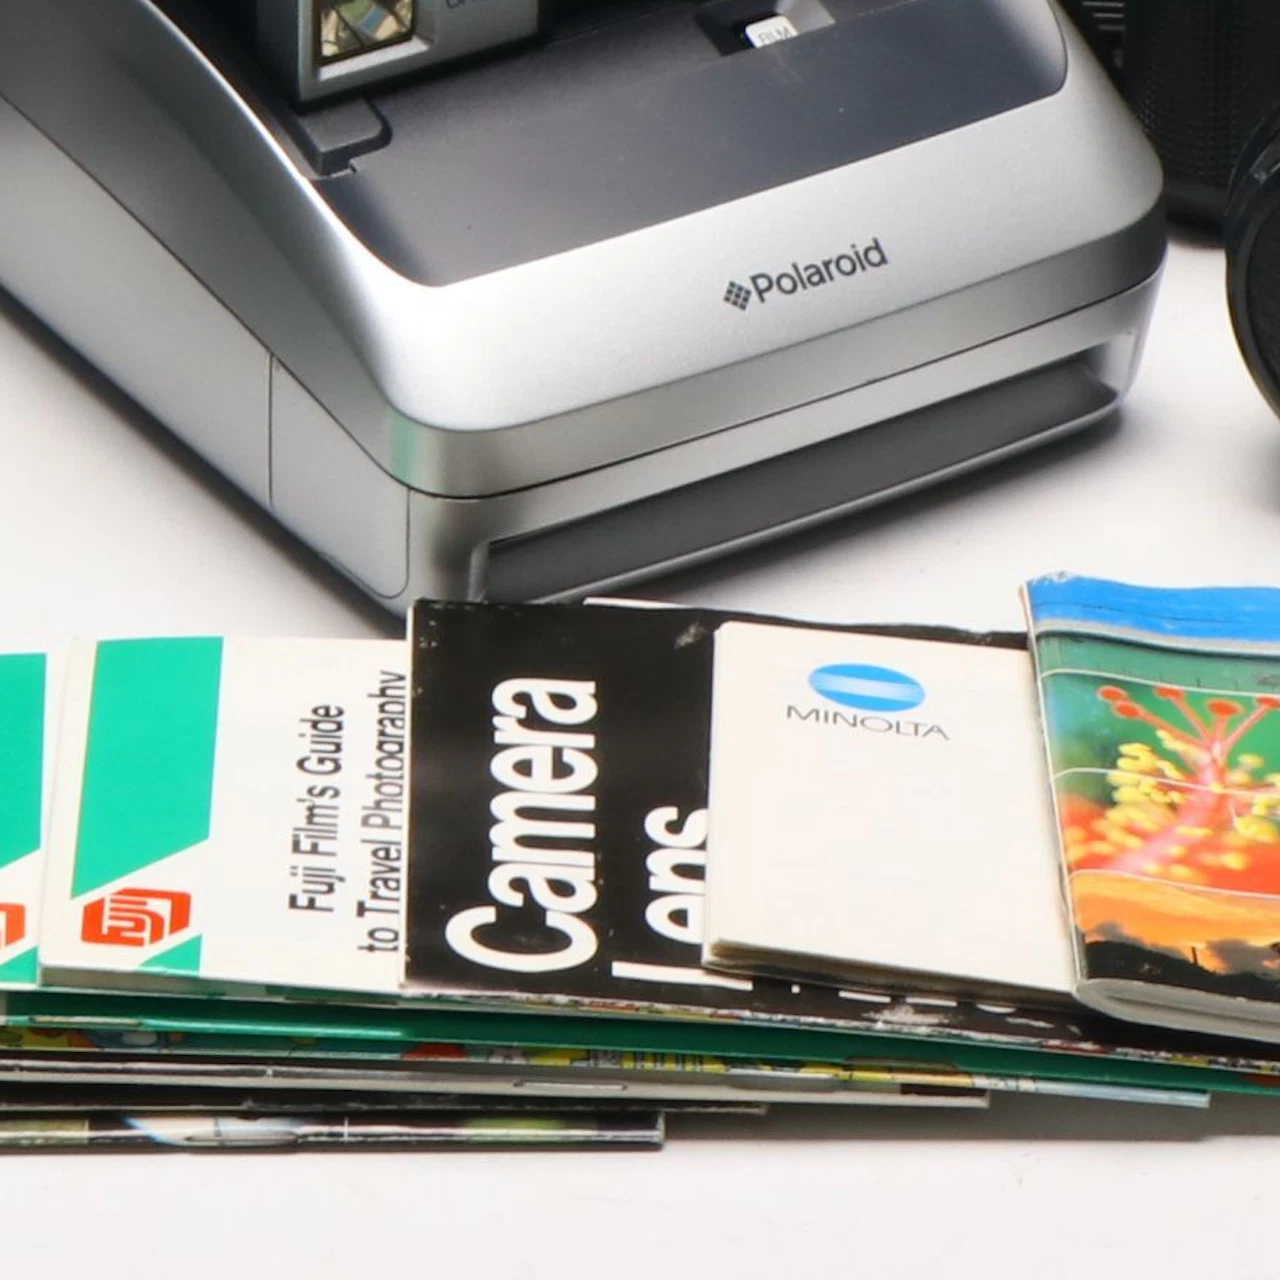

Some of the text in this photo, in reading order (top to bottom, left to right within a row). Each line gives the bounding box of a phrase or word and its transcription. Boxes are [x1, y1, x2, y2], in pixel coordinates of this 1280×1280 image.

[749, 237, 890, 304] Polaroid
[288, 703, 347, 914] Fuji Film's Guide
[356, 669, 407, 953] to Travel Photography
[445, 676, 598, 974] Camera
[786, 705, 950, 741] MINOLTA
